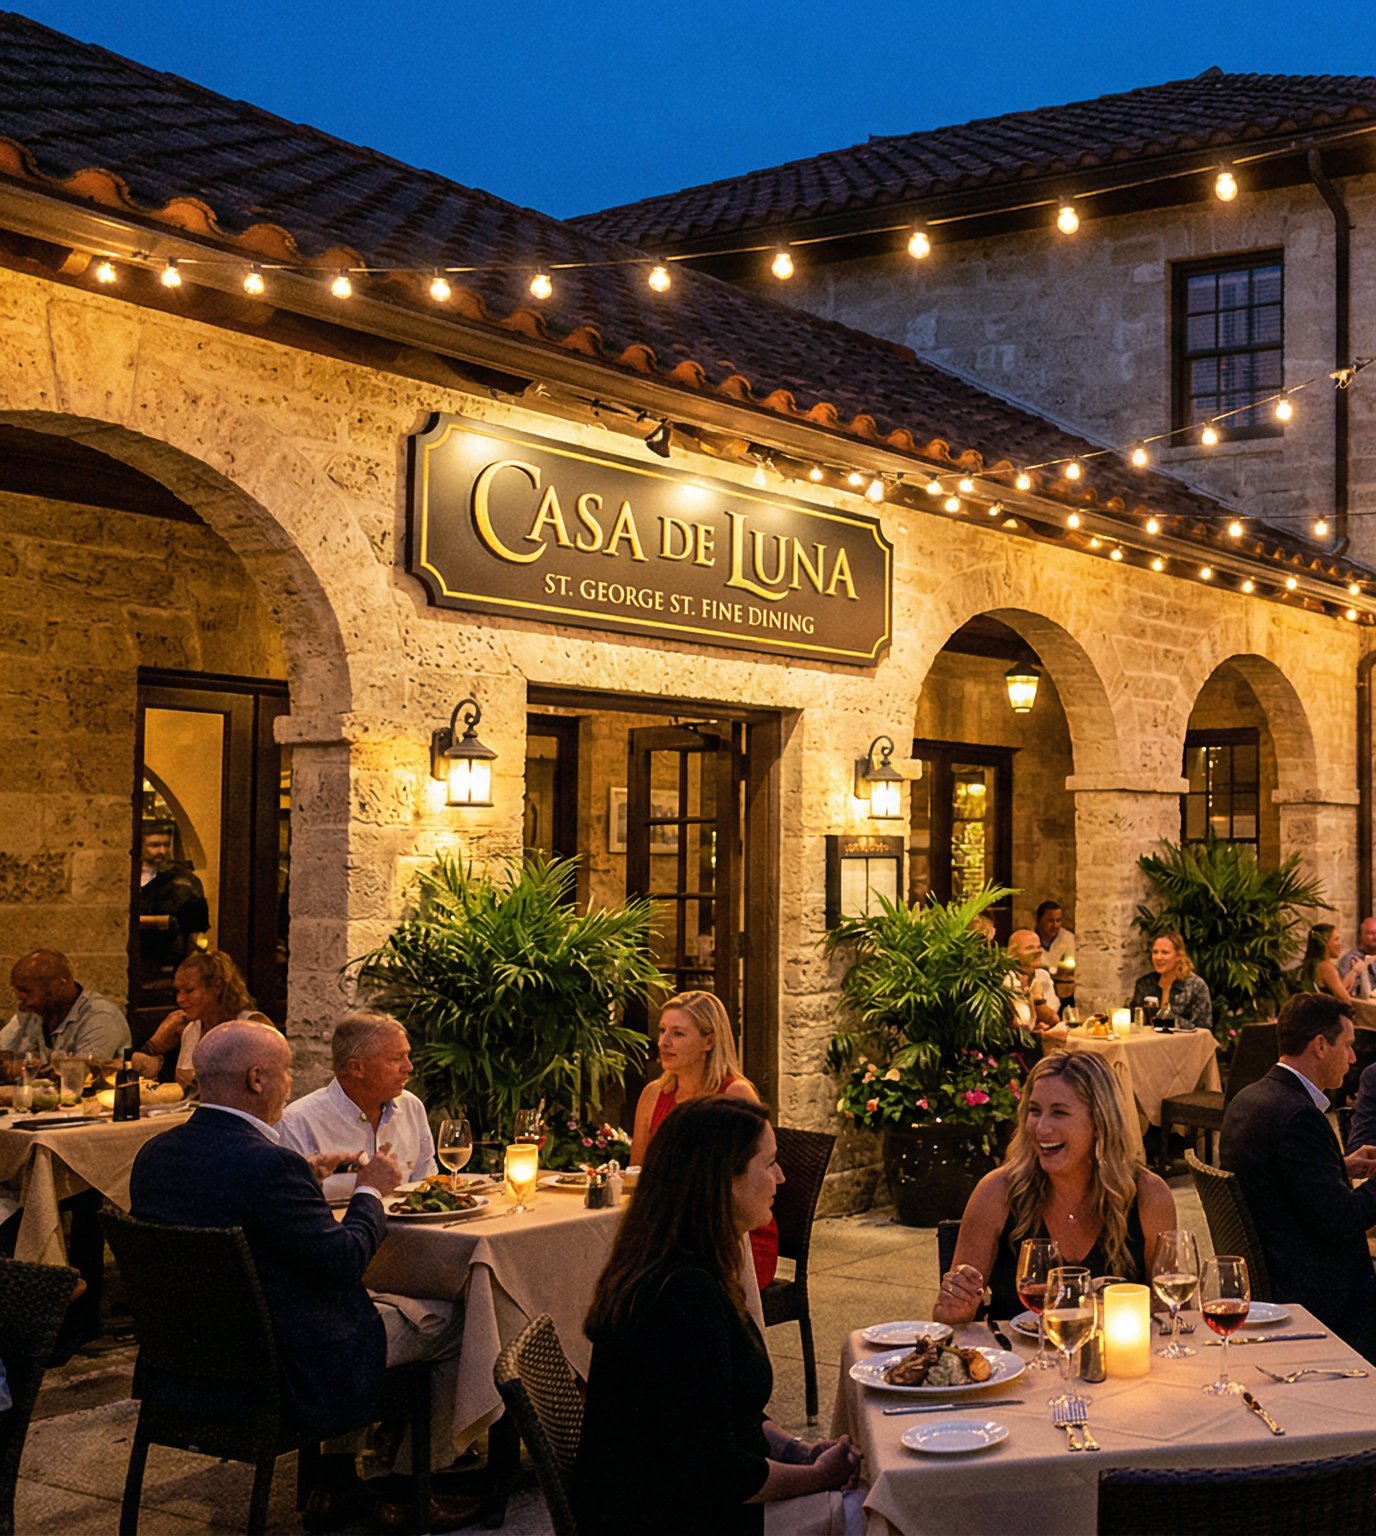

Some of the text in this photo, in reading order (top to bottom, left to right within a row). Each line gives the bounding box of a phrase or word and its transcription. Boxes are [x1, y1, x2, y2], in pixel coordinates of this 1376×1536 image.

[472, 460, 860, 602] CASA DE LUNA
[544, 572, 815, 635] ST. GEORGE ST. FINE DINING
